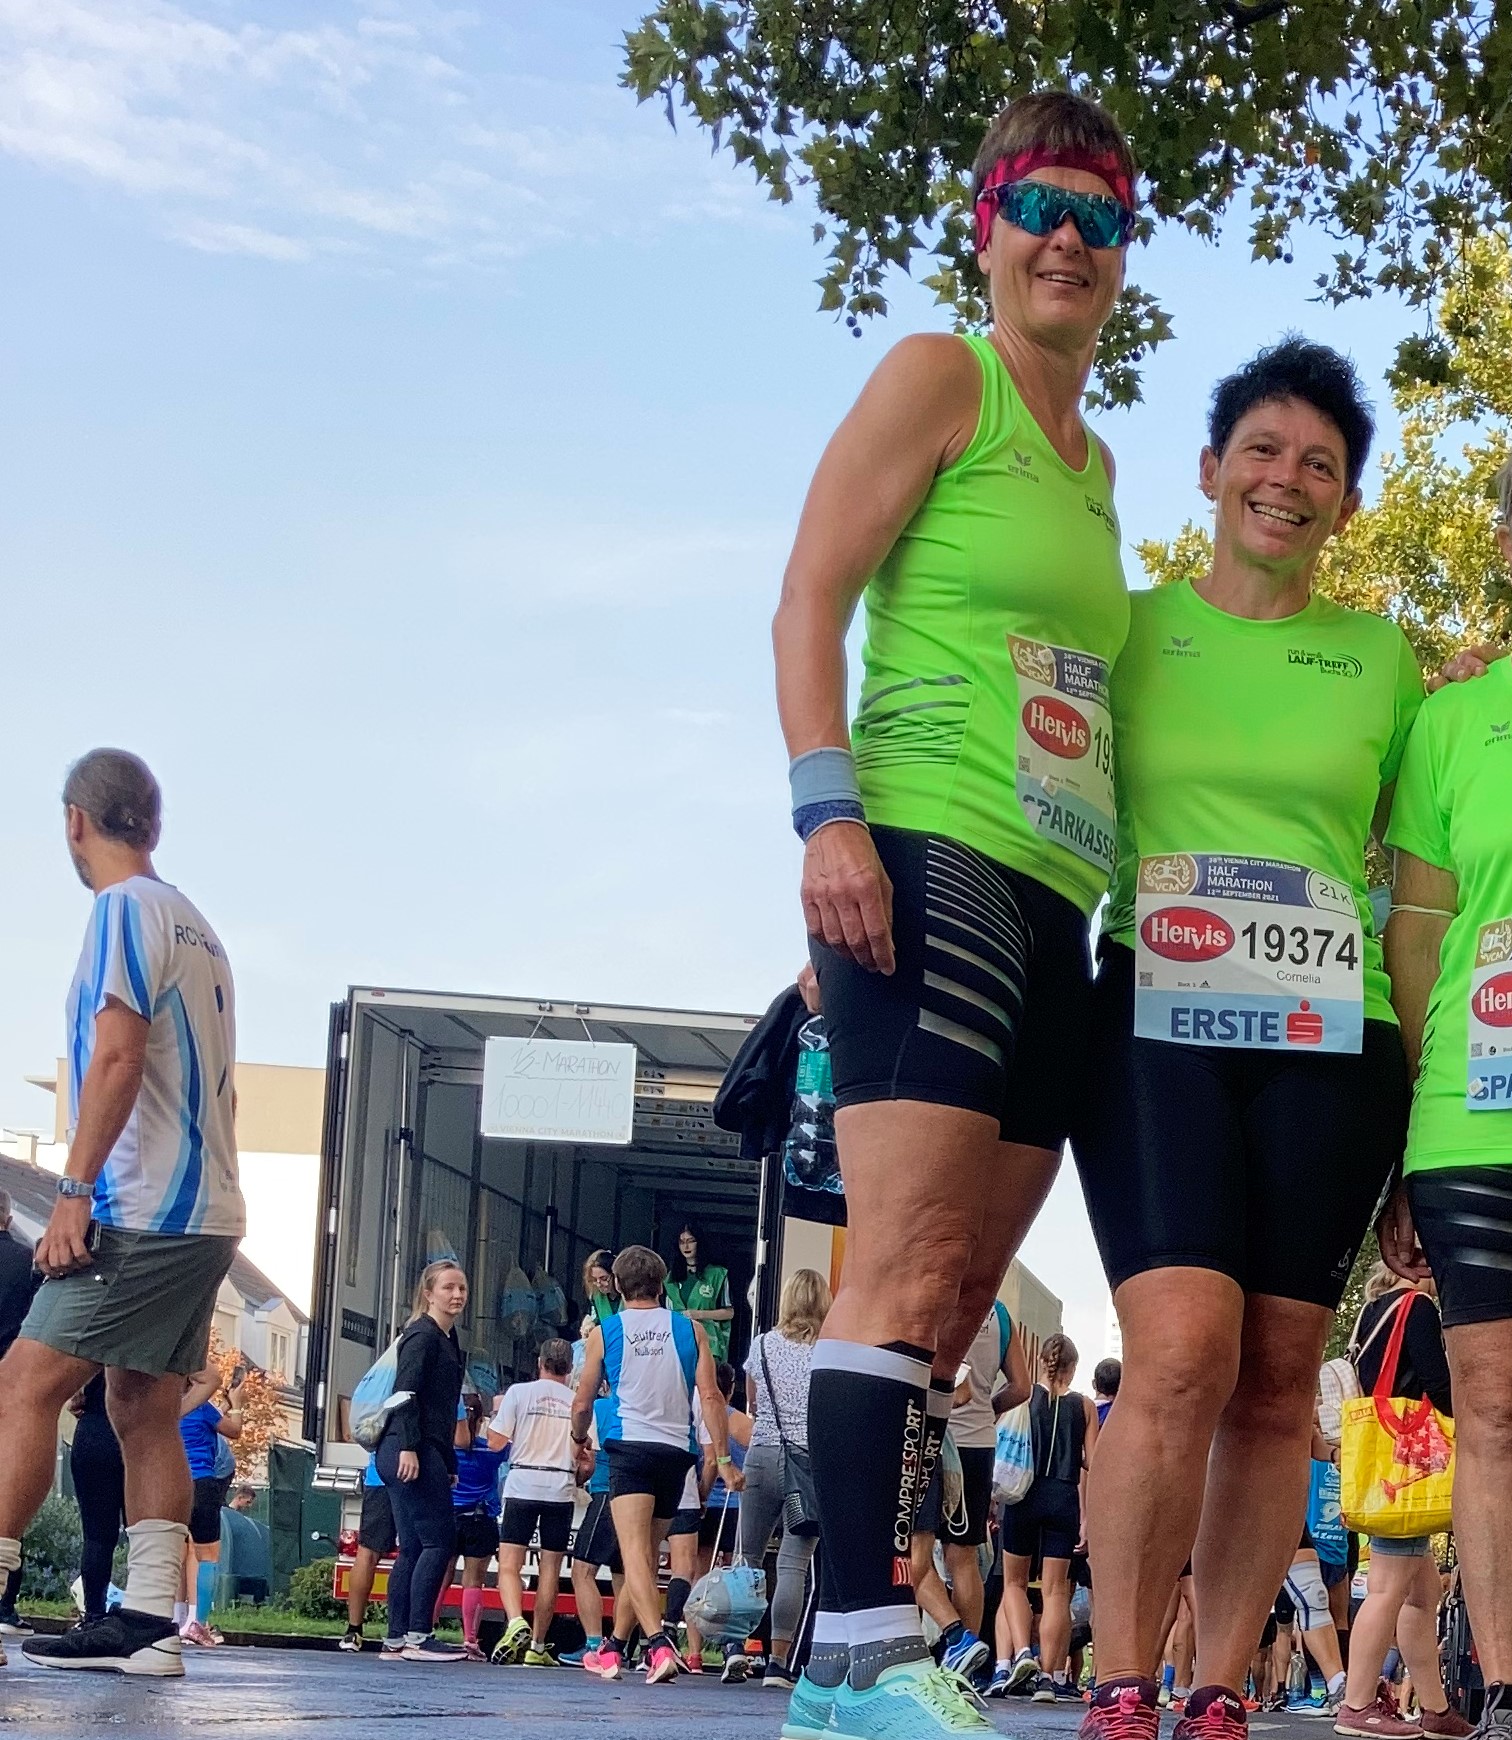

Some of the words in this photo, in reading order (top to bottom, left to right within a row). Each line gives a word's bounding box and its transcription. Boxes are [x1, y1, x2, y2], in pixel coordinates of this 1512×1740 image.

[1064, 662, 1091, 676] HALF
[1030, 702, 1087, 748] Hervis
[1223, 858, 1249, 867] VIENNA
[1250, 859, 1265, 867] CITY
[1208, 865, 1239, 877] HALF
[1154, 883, 1180, 893] VCM
[1207, 876, 1273, 892] MARATHON
[1151, 916, 1228, 950] Hervis
[1241, 921, 1358, 971] 19374
[1276, 970, 1321, 984] Cornelia
[1171, 1007, 1280, 1043] ERSTE
[500, 1126, 535, 1135] VIENNA
[537, 1127, 558, 1136] CITY
[561, 1129, 614, 1138] MARATHON
[625, 1330, 671, 1345] Lauftreff
